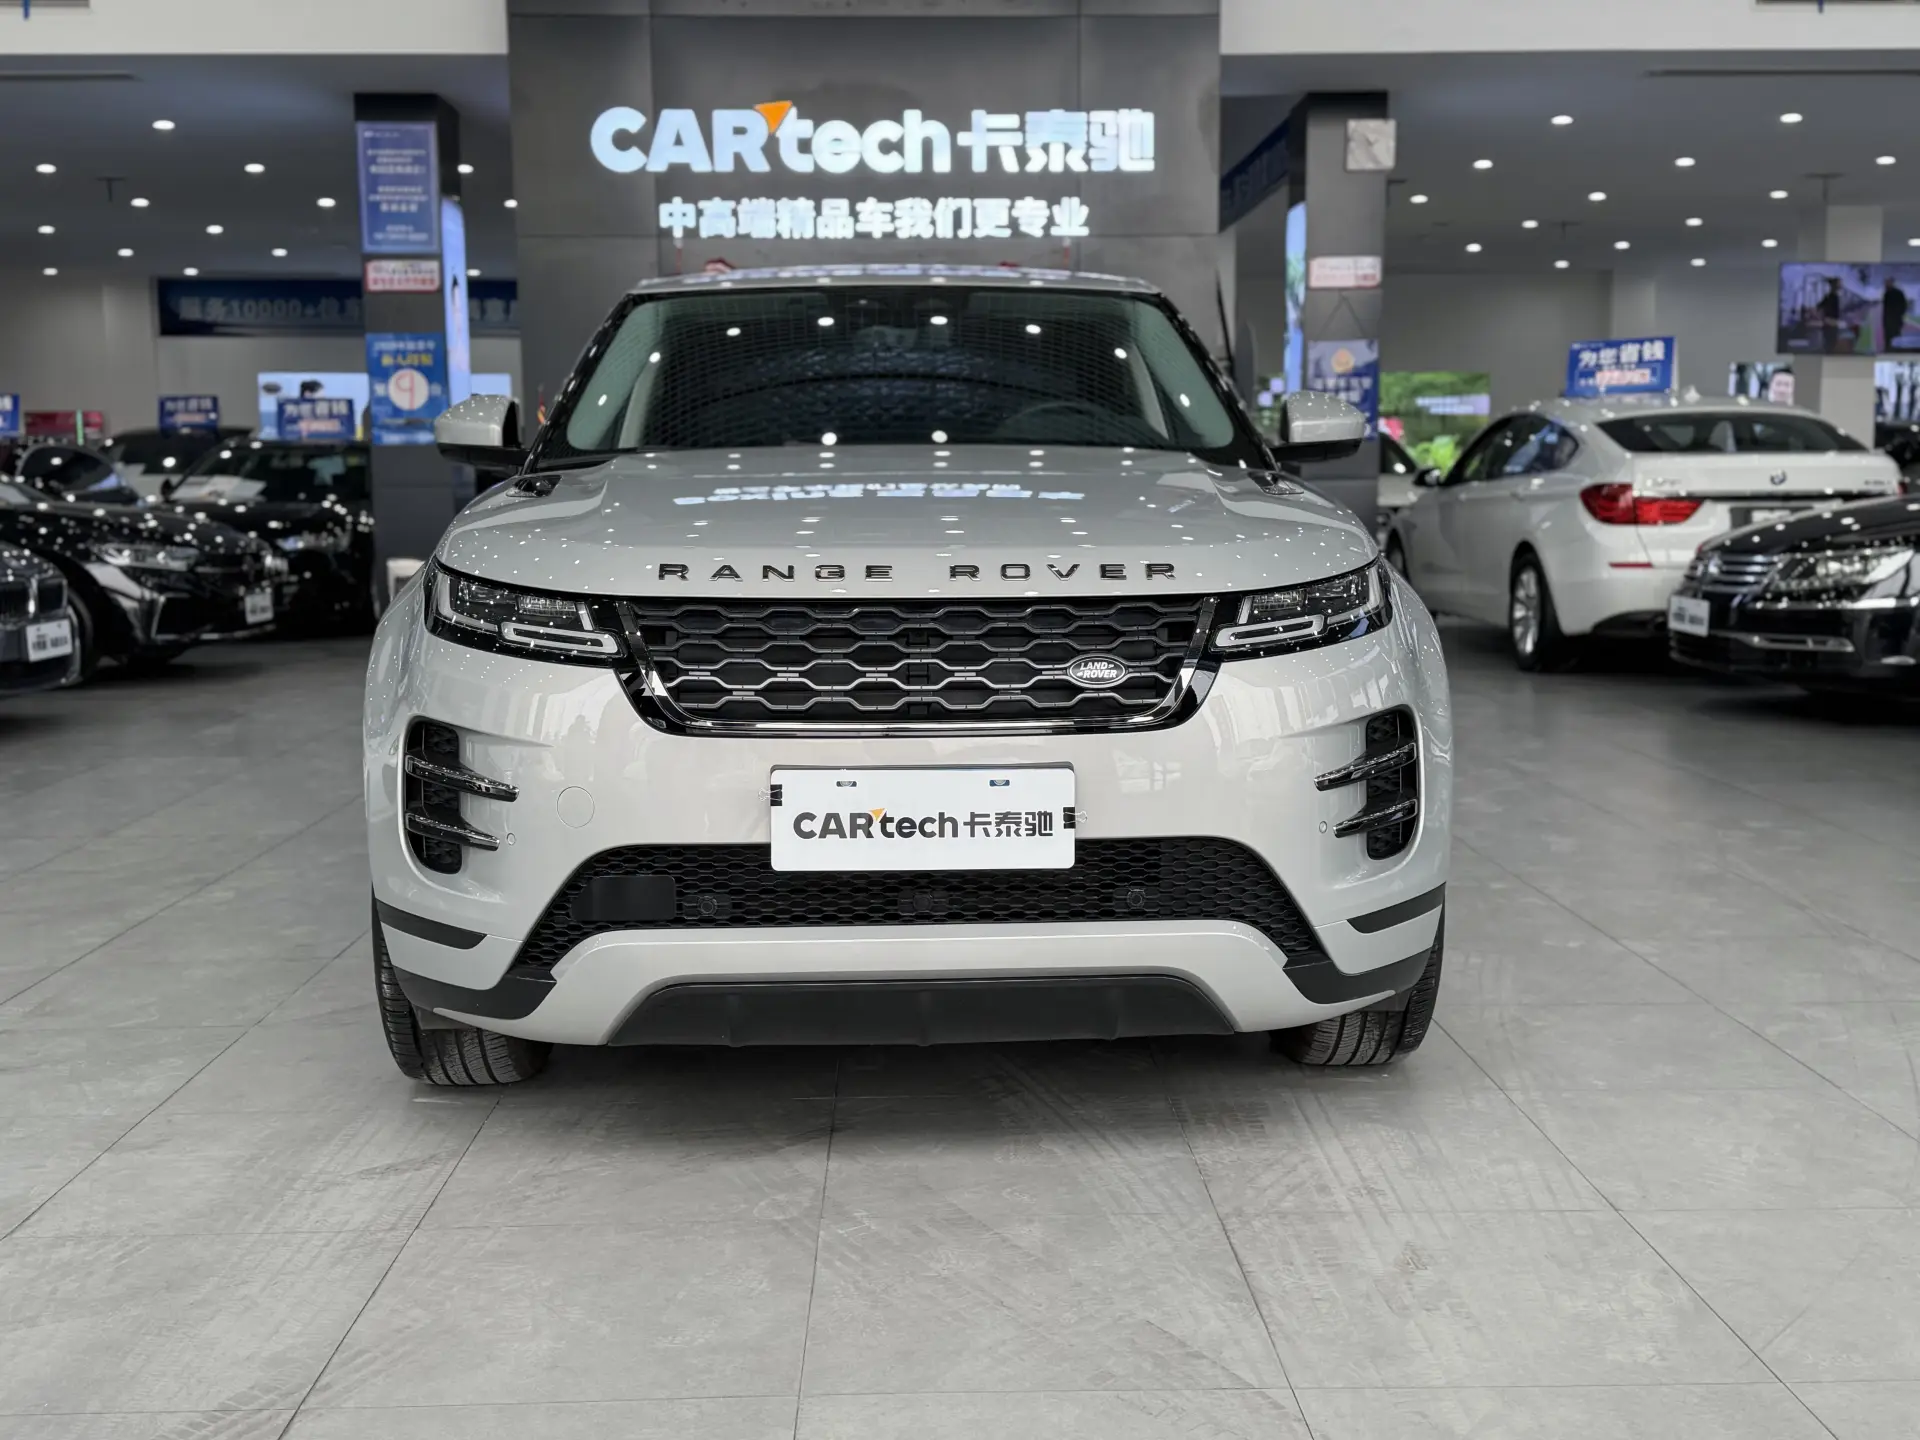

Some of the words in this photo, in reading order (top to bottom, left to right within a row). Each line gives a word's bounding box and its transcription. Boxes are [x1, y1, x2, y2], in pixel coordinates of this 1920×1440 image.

[589, 103, 952, 174] CARtech
[956, 108, 1156, 173] 卡泰驰
[658, 196, 1090, 239] 中高端精品车我们更专业
[657, 562, 894, 582] RANGE
[948, 562, 1177, 582] ROVER
[1080, 661, 1109, 670] LAND
[1082, 669, 1118, 679] ROVER
[793, 808, 958, 839] CARtech
[962, 811, 1053, 838] 卡泰驰
